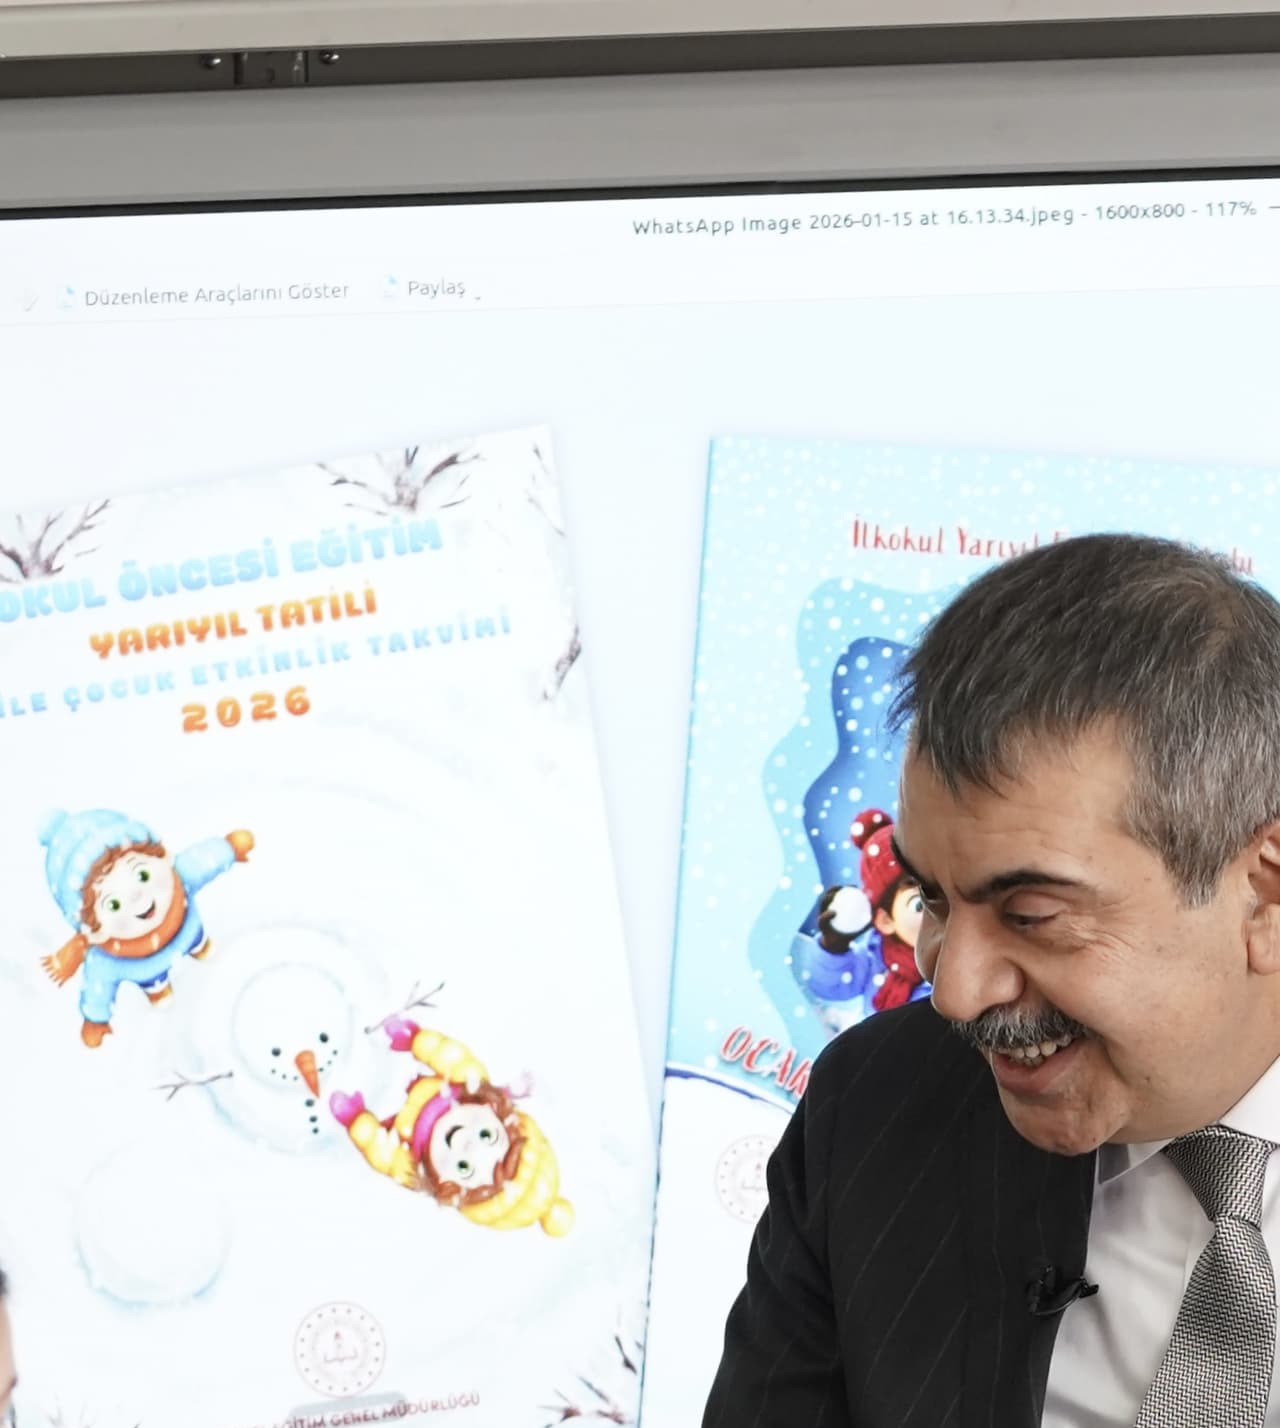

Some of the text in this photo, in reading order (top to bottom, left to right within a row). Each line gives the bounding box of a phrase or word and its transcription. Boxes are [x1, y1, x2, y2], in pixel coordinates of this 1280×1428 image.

[633, 217, 734, 236] WhatsApp
[742, 215, 801, 234] Image
[809, 211, 913, 229] 2026-01-15
[920, 211, 938, 226] at
[947, 207, 1074, 226] 16.13.34.jpeg
[1095, 203, 1185, 220] 1600x800
[1205, 201, 1257, 217] 117%
[86, 282, 349, 306] Düzenleme Araçlarını Göster
[408, 279, 466, 298] Paylaş
[853, 513, 943, 554] İlkokul
[118, 537, 279, 602] ÖNCESİ
[290, 516, 443, 573] EĞİTİM
[89, 580, 377, 660] YARIYIL TATİLİ
[63, 671, 175, 713] ÇOCUK
[191, 636, 351, 686] ETKİNLİK
[367, 603, 511, 656] TAKVİMİ
[181, 685, 311, 734] 2026
[330, 1408, 380, 1428] GENEL
